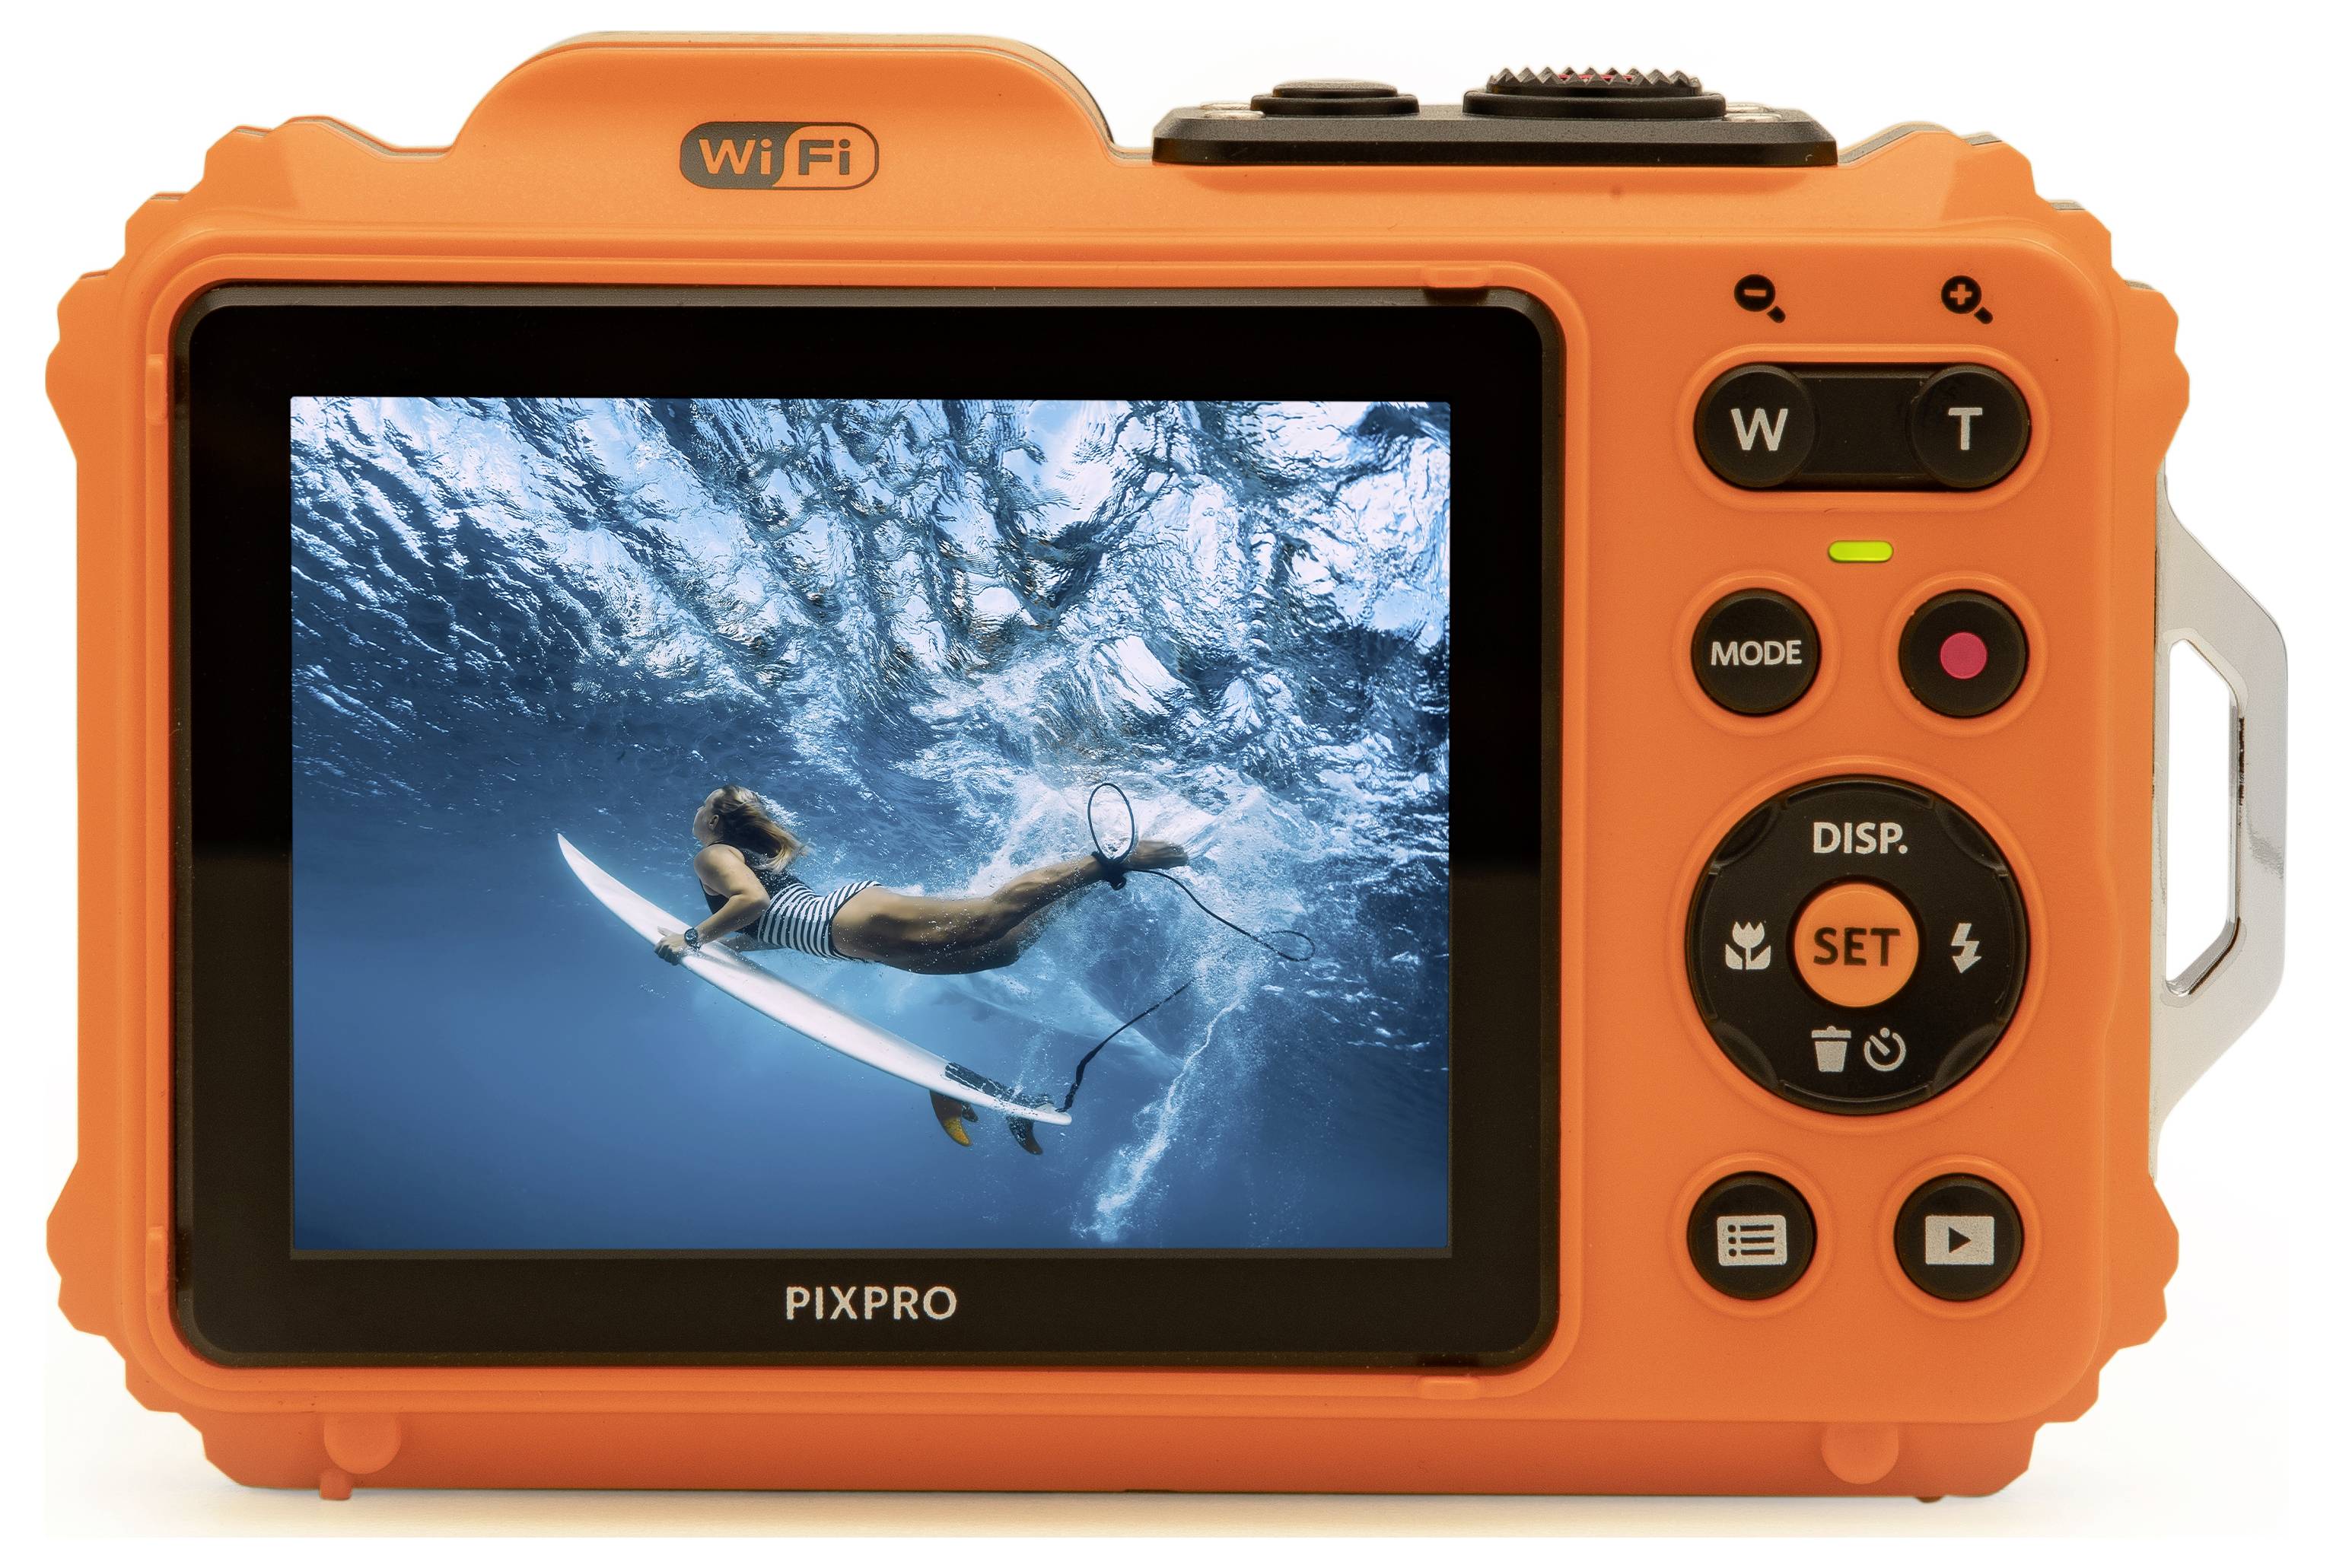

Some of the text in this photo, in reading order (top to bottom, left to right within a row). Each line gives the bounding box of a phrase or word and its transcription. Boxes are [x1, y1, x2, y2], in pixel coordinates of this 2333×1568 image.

[1730, 407, 1788, 452] W
[1948, 407, 1983, 451] T
[1710, 639, 1803, 666] MODE
[1813, 822, 1908, 854] DISP.
[1813, 927, 1901, 966] SET
[786, 1286, 957, 1320] PIXPRO
